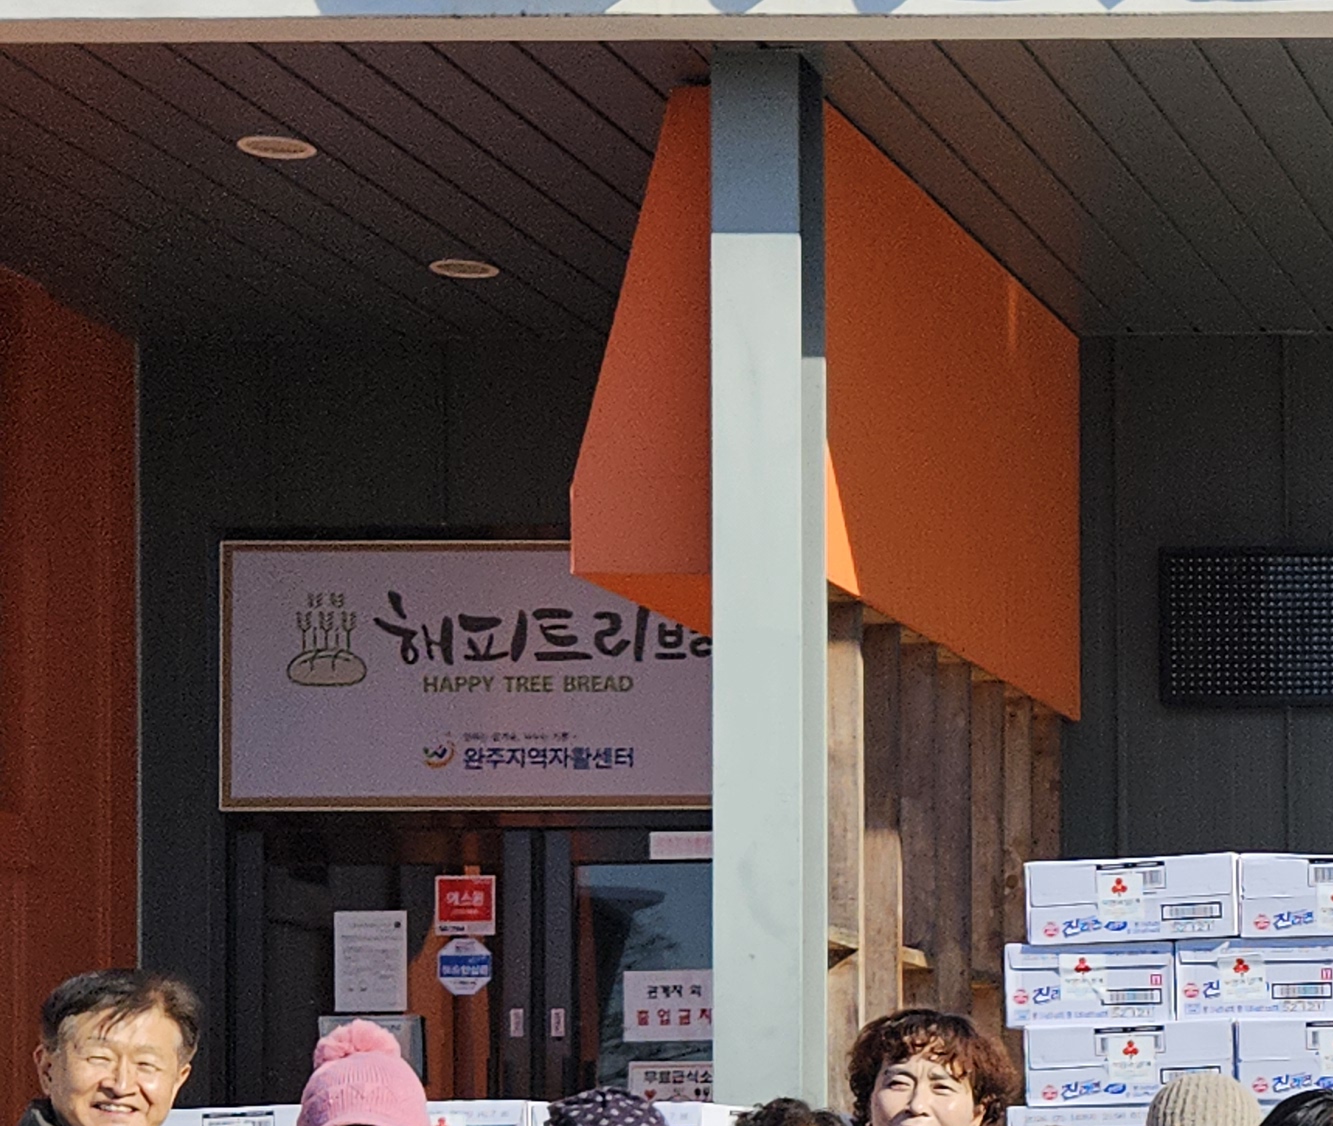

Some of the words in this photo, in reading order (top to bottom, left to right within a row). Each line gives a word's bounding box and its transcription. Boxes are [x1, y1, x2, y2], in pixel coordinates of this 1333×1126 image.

[423, 675, 493, 694] HAPPY
[504, 675, 553, 694] TREE
[563, 675, 634, 694] BREAD
[464, 747, 634, 771] 완주지역자활센터
